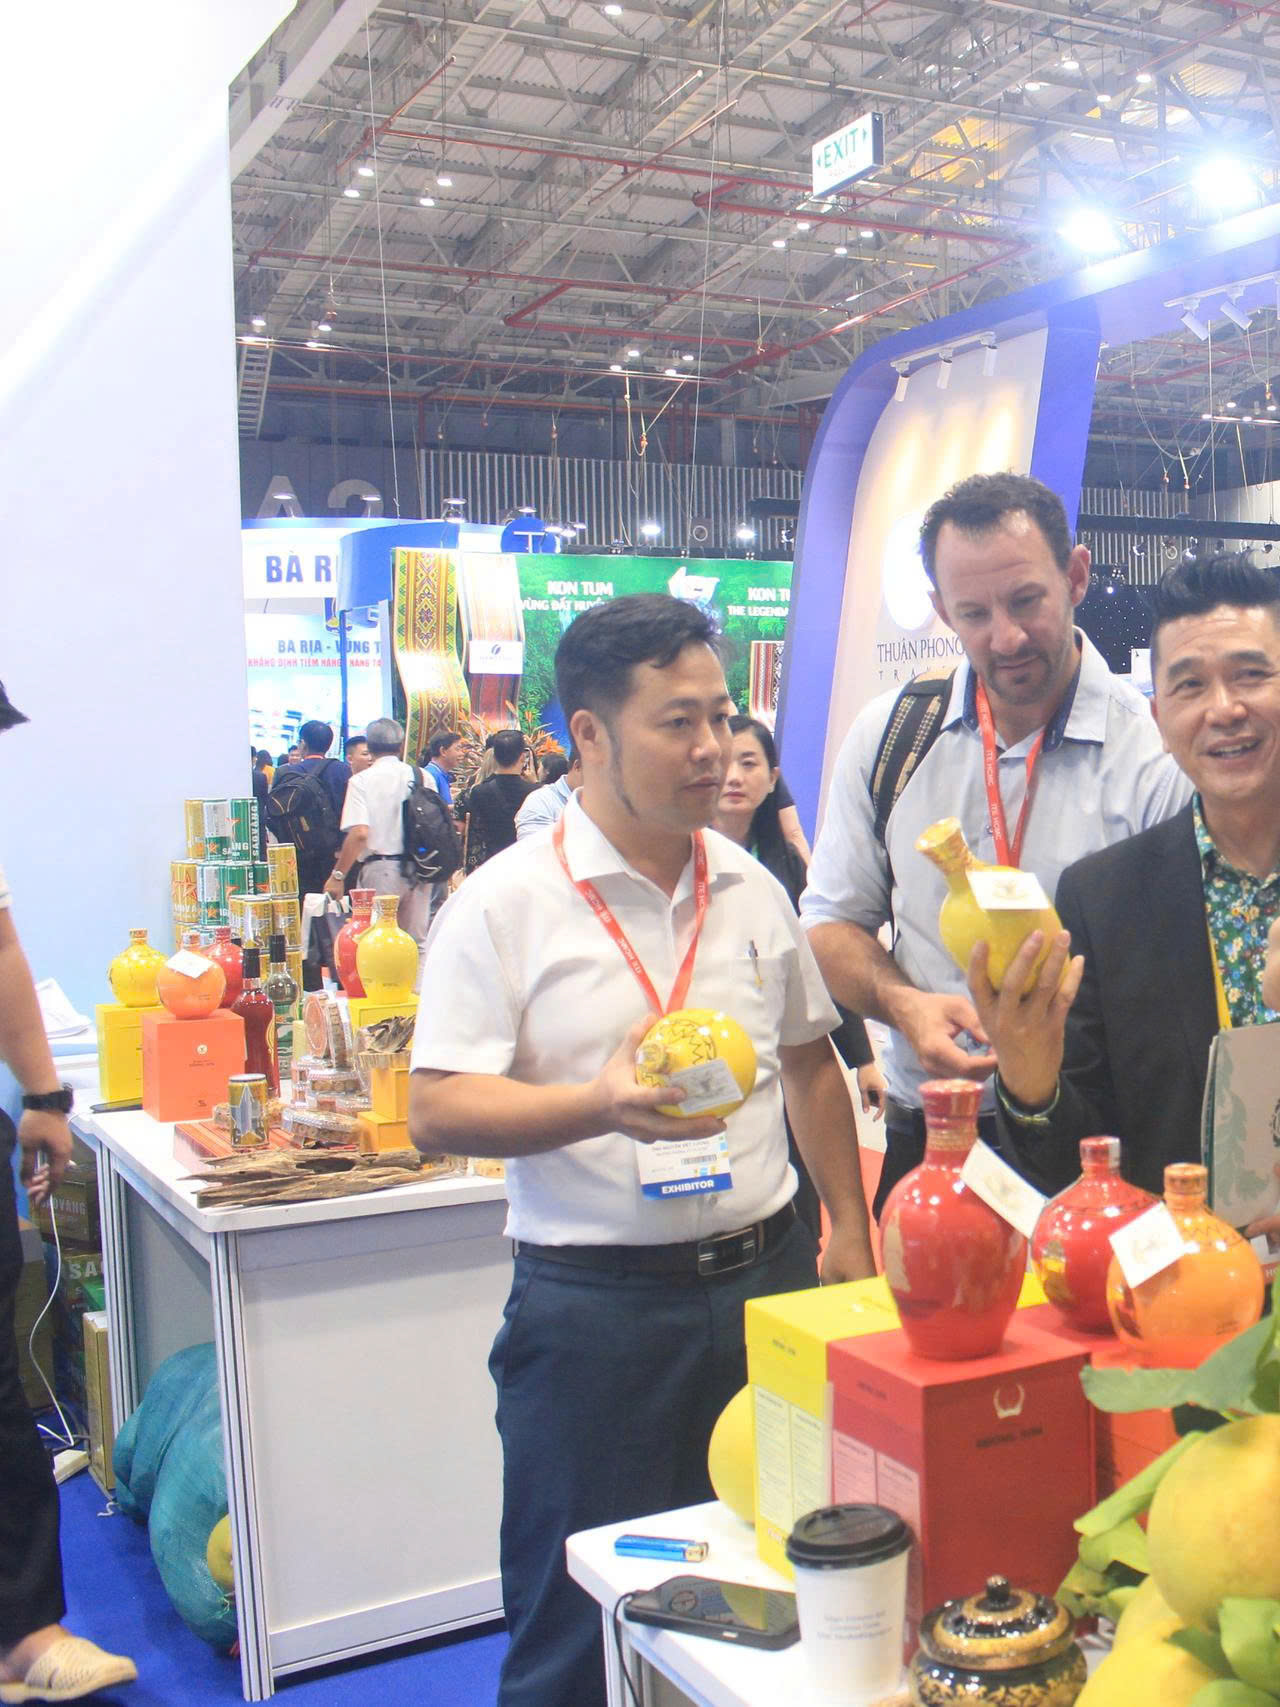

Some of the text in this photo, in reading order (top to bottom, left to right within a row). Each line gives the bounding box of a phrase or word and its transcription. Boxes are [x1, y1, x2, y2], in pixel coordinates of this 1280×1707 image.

[824, 127, 859, 168] EXIT
[547, 581, 614, 596] KON TUM
[747, 587, 776, 601] KON
[727, 605, 746, 616] THE
[661, 1179, 715, 1194] EXHIBITOR
